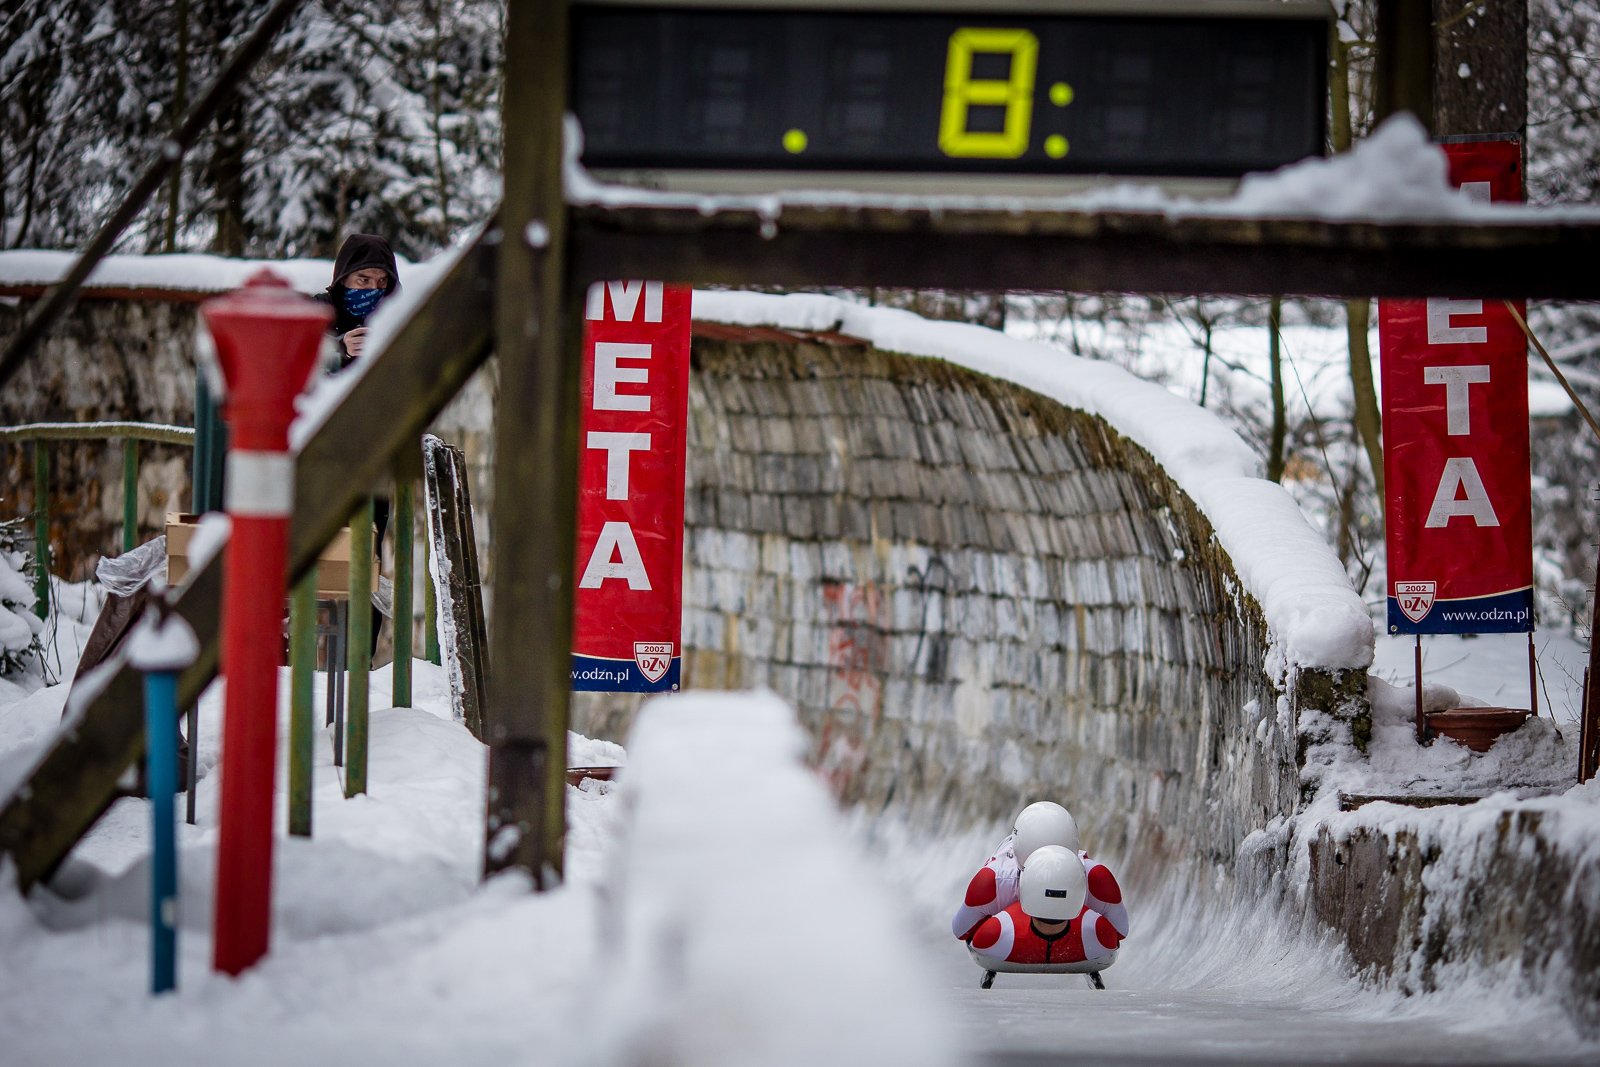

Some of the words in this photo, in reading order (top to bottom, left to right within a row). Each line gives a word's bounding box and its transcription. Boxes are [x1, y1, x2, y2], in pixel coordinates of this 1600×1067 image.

[1424, 181, 1500, 528] ETA
[578, 280, 664, 591] META
[1404, 596, 1429, 612] DZN
[1442, 607, 1529, 622] www.odzn.pl
[644, 645, 665, 653] 2002
[642, 657, 666, 672] DZN
[569, 667, 629, 684] w.odzn.pl
